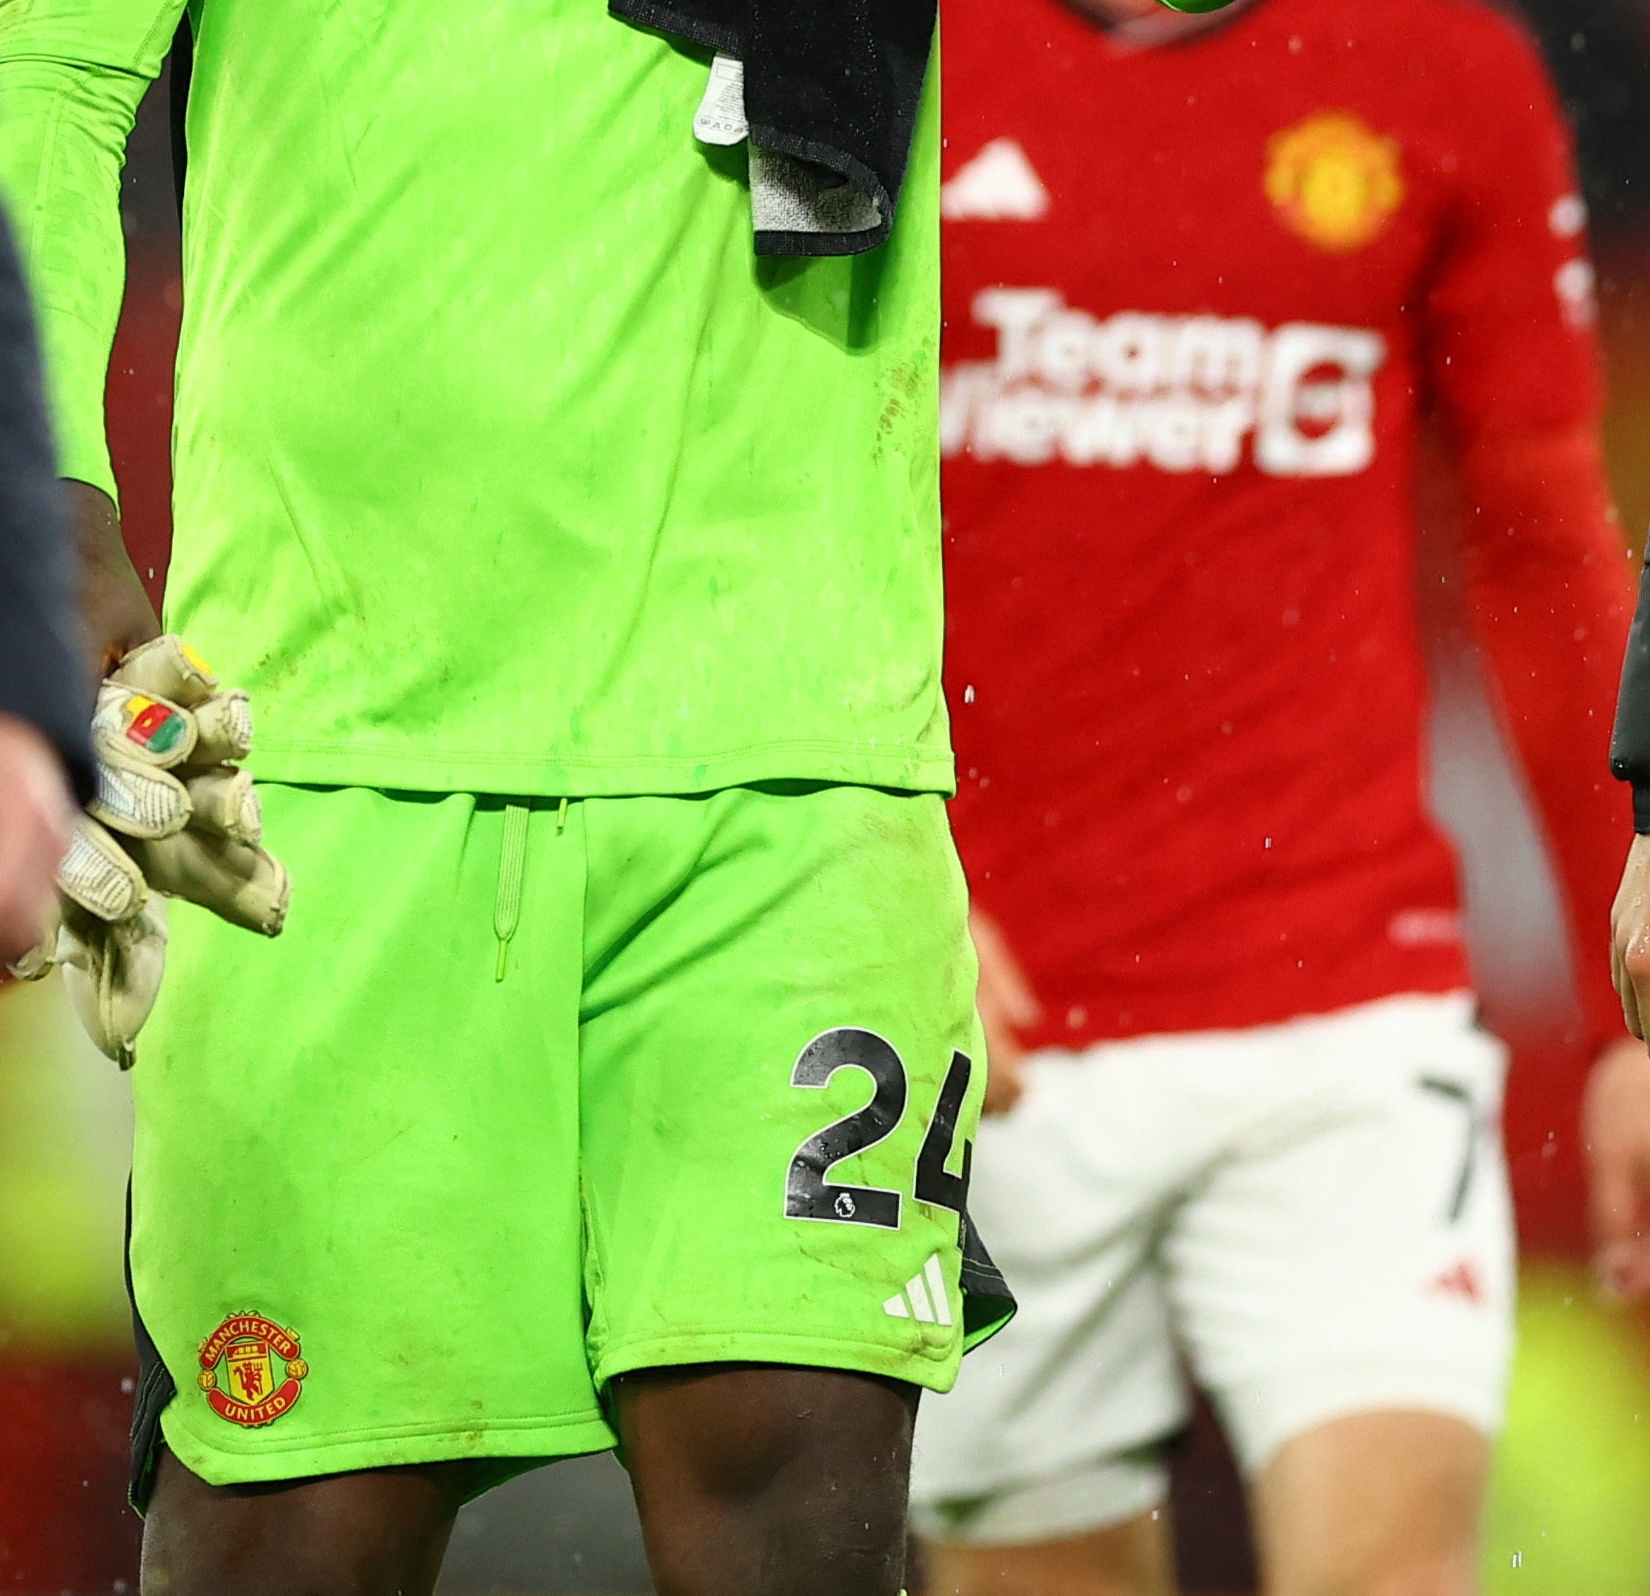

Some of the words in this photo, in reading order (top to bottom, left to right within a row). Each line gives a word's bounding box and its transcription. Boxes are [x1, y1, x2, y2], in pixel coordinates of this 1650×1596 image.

[971, 287, 1267, 389] Team
[784, 1025, 974, 1251] 24
[1413, 1068, 1481, 1228] 7
[204, 1320, 292, 1362] MANCHESTER
[224, 1396, 287, 1421] UNITED
